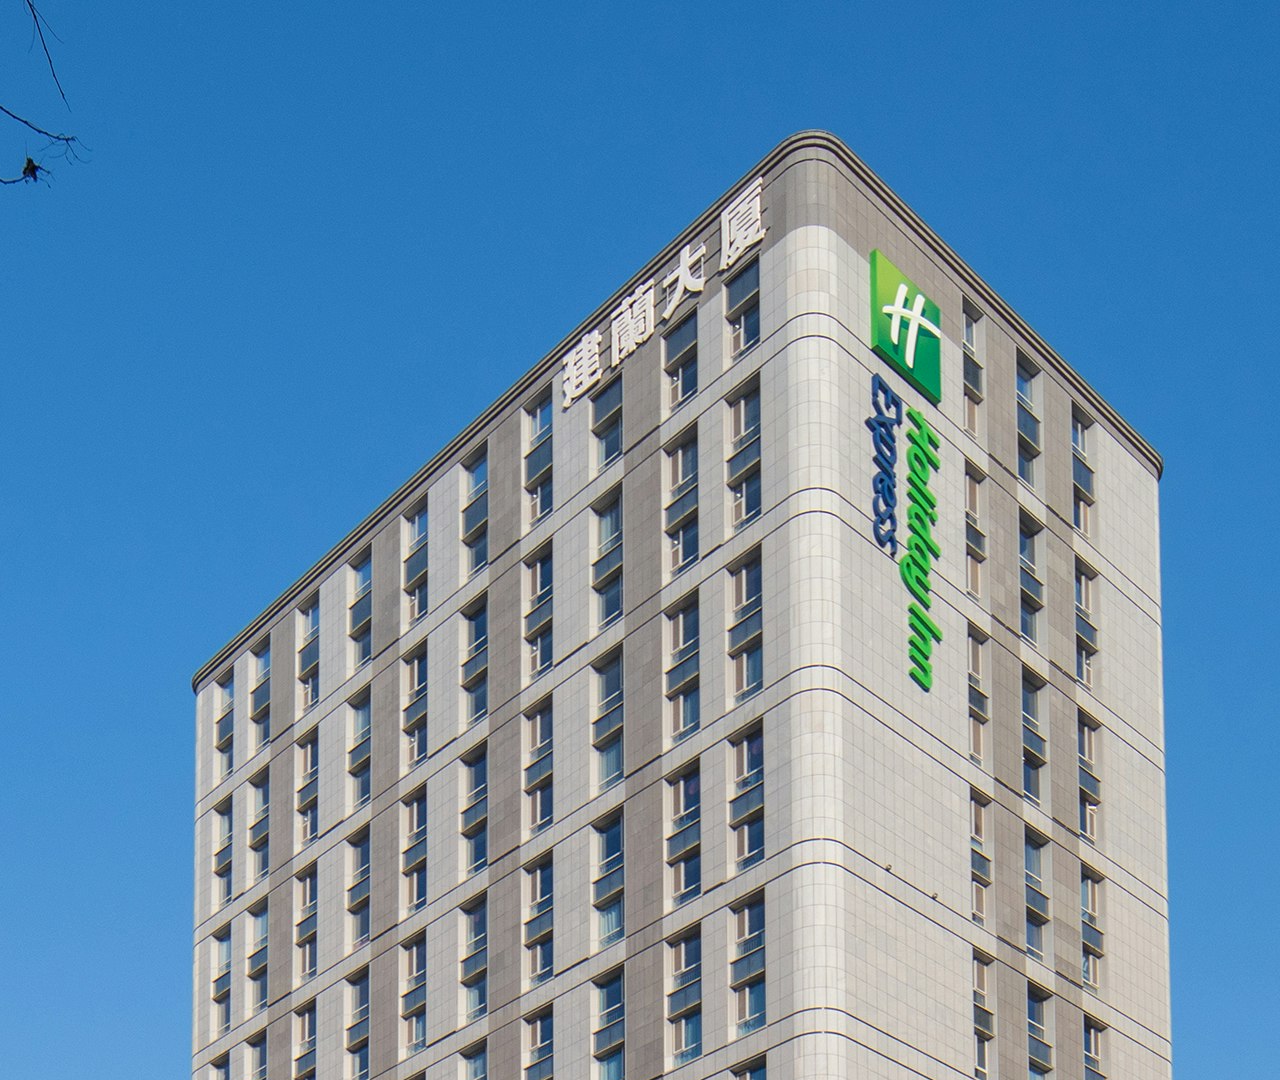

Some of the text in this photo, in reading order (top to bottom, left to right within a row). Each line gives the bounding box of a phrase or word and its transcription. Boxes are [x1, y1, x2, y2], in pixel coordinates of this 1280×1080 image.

[864, 373, 902, 559] Express
[901, 407, 942, 693] Holiday Inn
